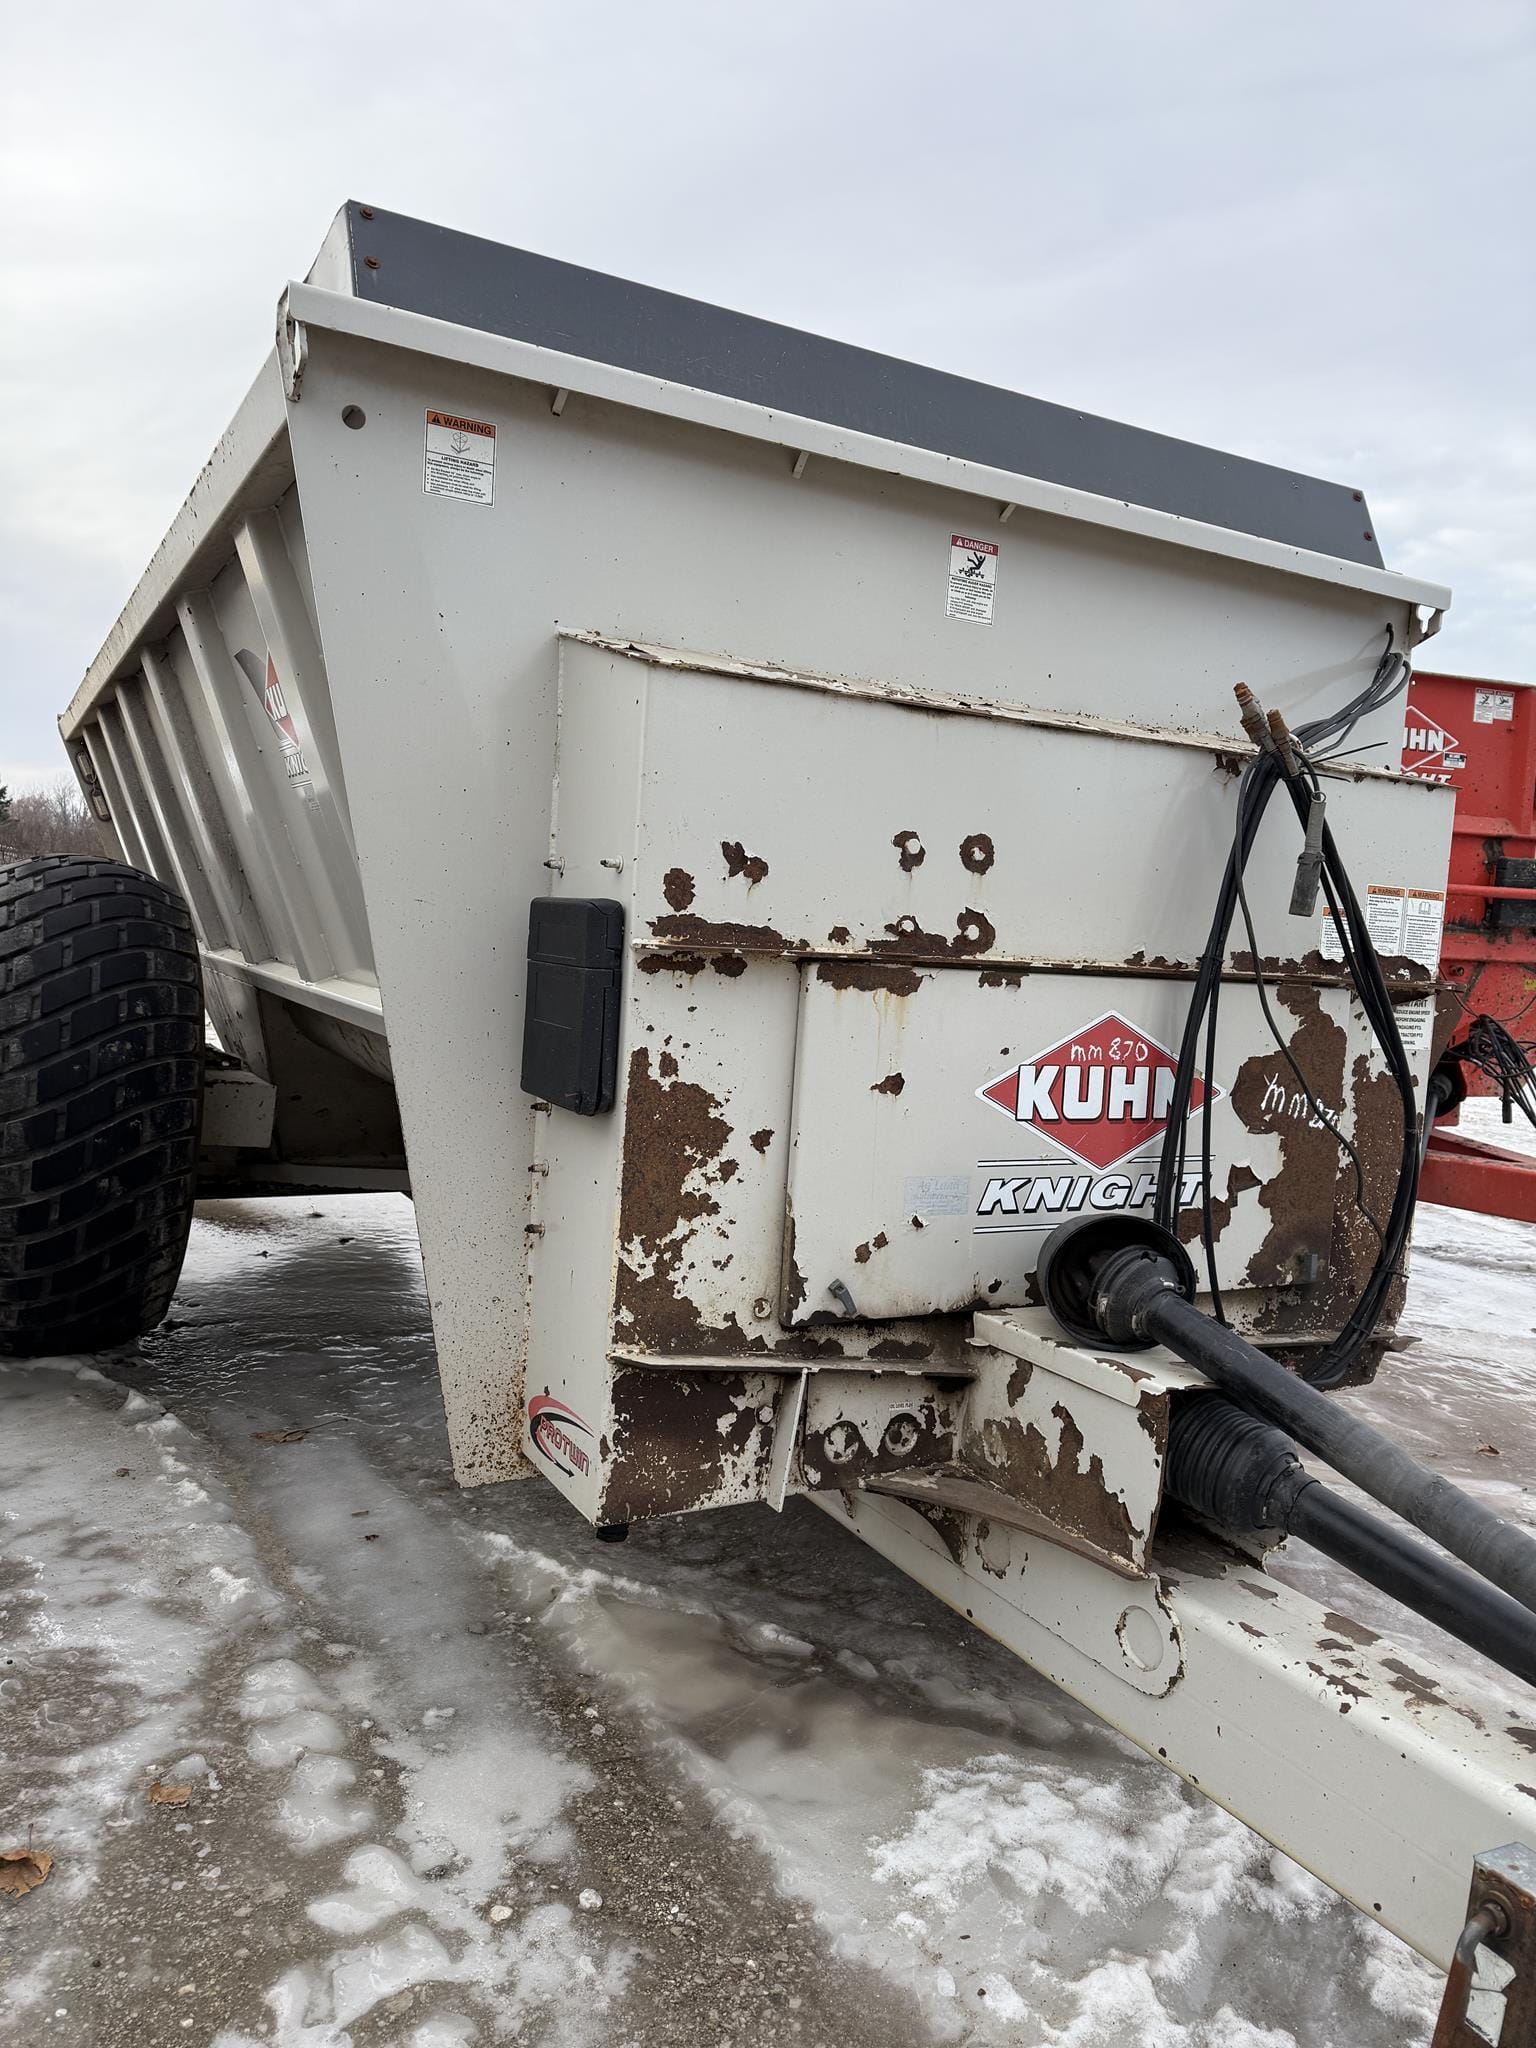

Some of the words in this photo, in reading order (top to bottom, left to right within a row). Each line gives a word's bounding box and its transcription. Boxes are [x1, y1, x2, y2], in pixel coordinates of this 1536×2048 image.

[443, 416, 491, 435] WARNING
[964, 539, 994, 553] DANGER
[1108, 1037, 1149, 1062] 870
